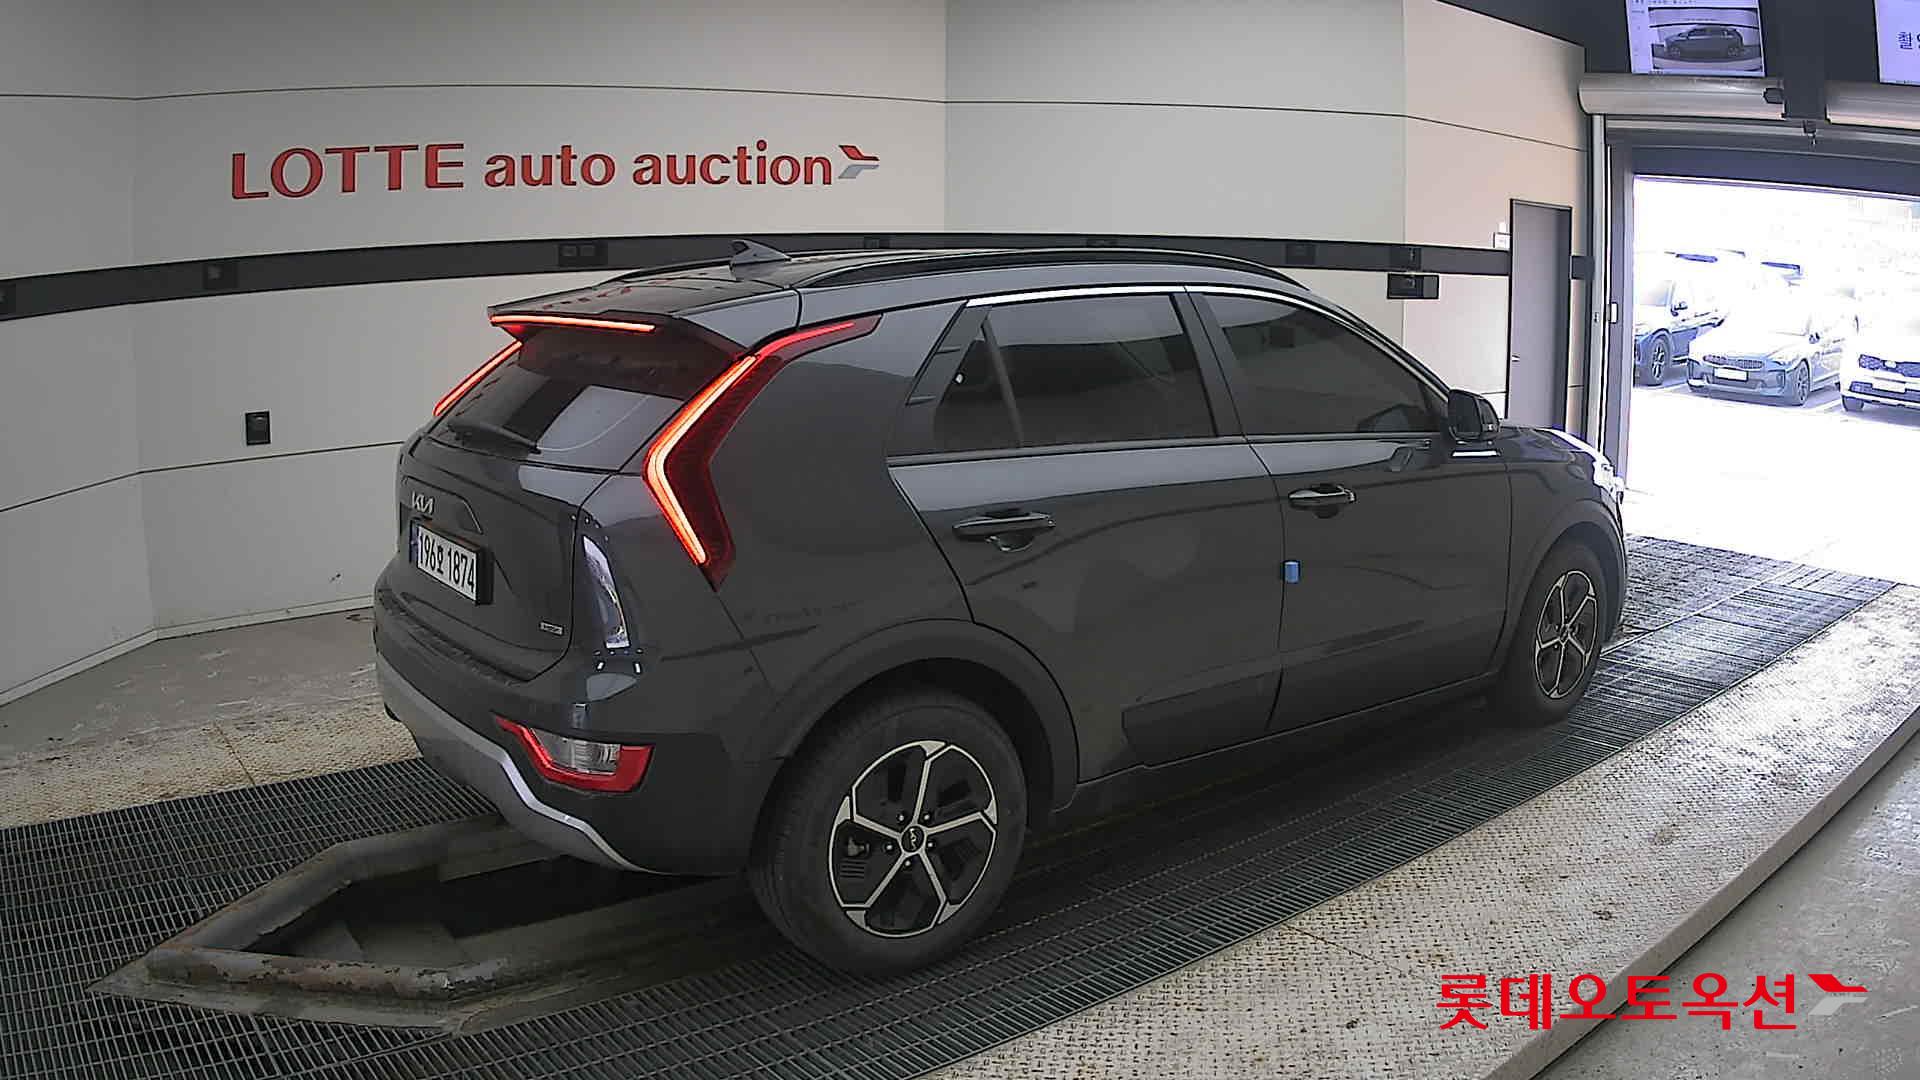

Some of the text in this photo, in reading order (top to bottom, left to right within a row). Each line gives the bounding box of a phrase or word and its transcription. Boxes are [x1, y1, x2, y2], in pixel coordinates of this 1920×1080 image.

[231, 140, 833, 200] LOTTE auto auction
[448, 547, 475, 594] 1874
